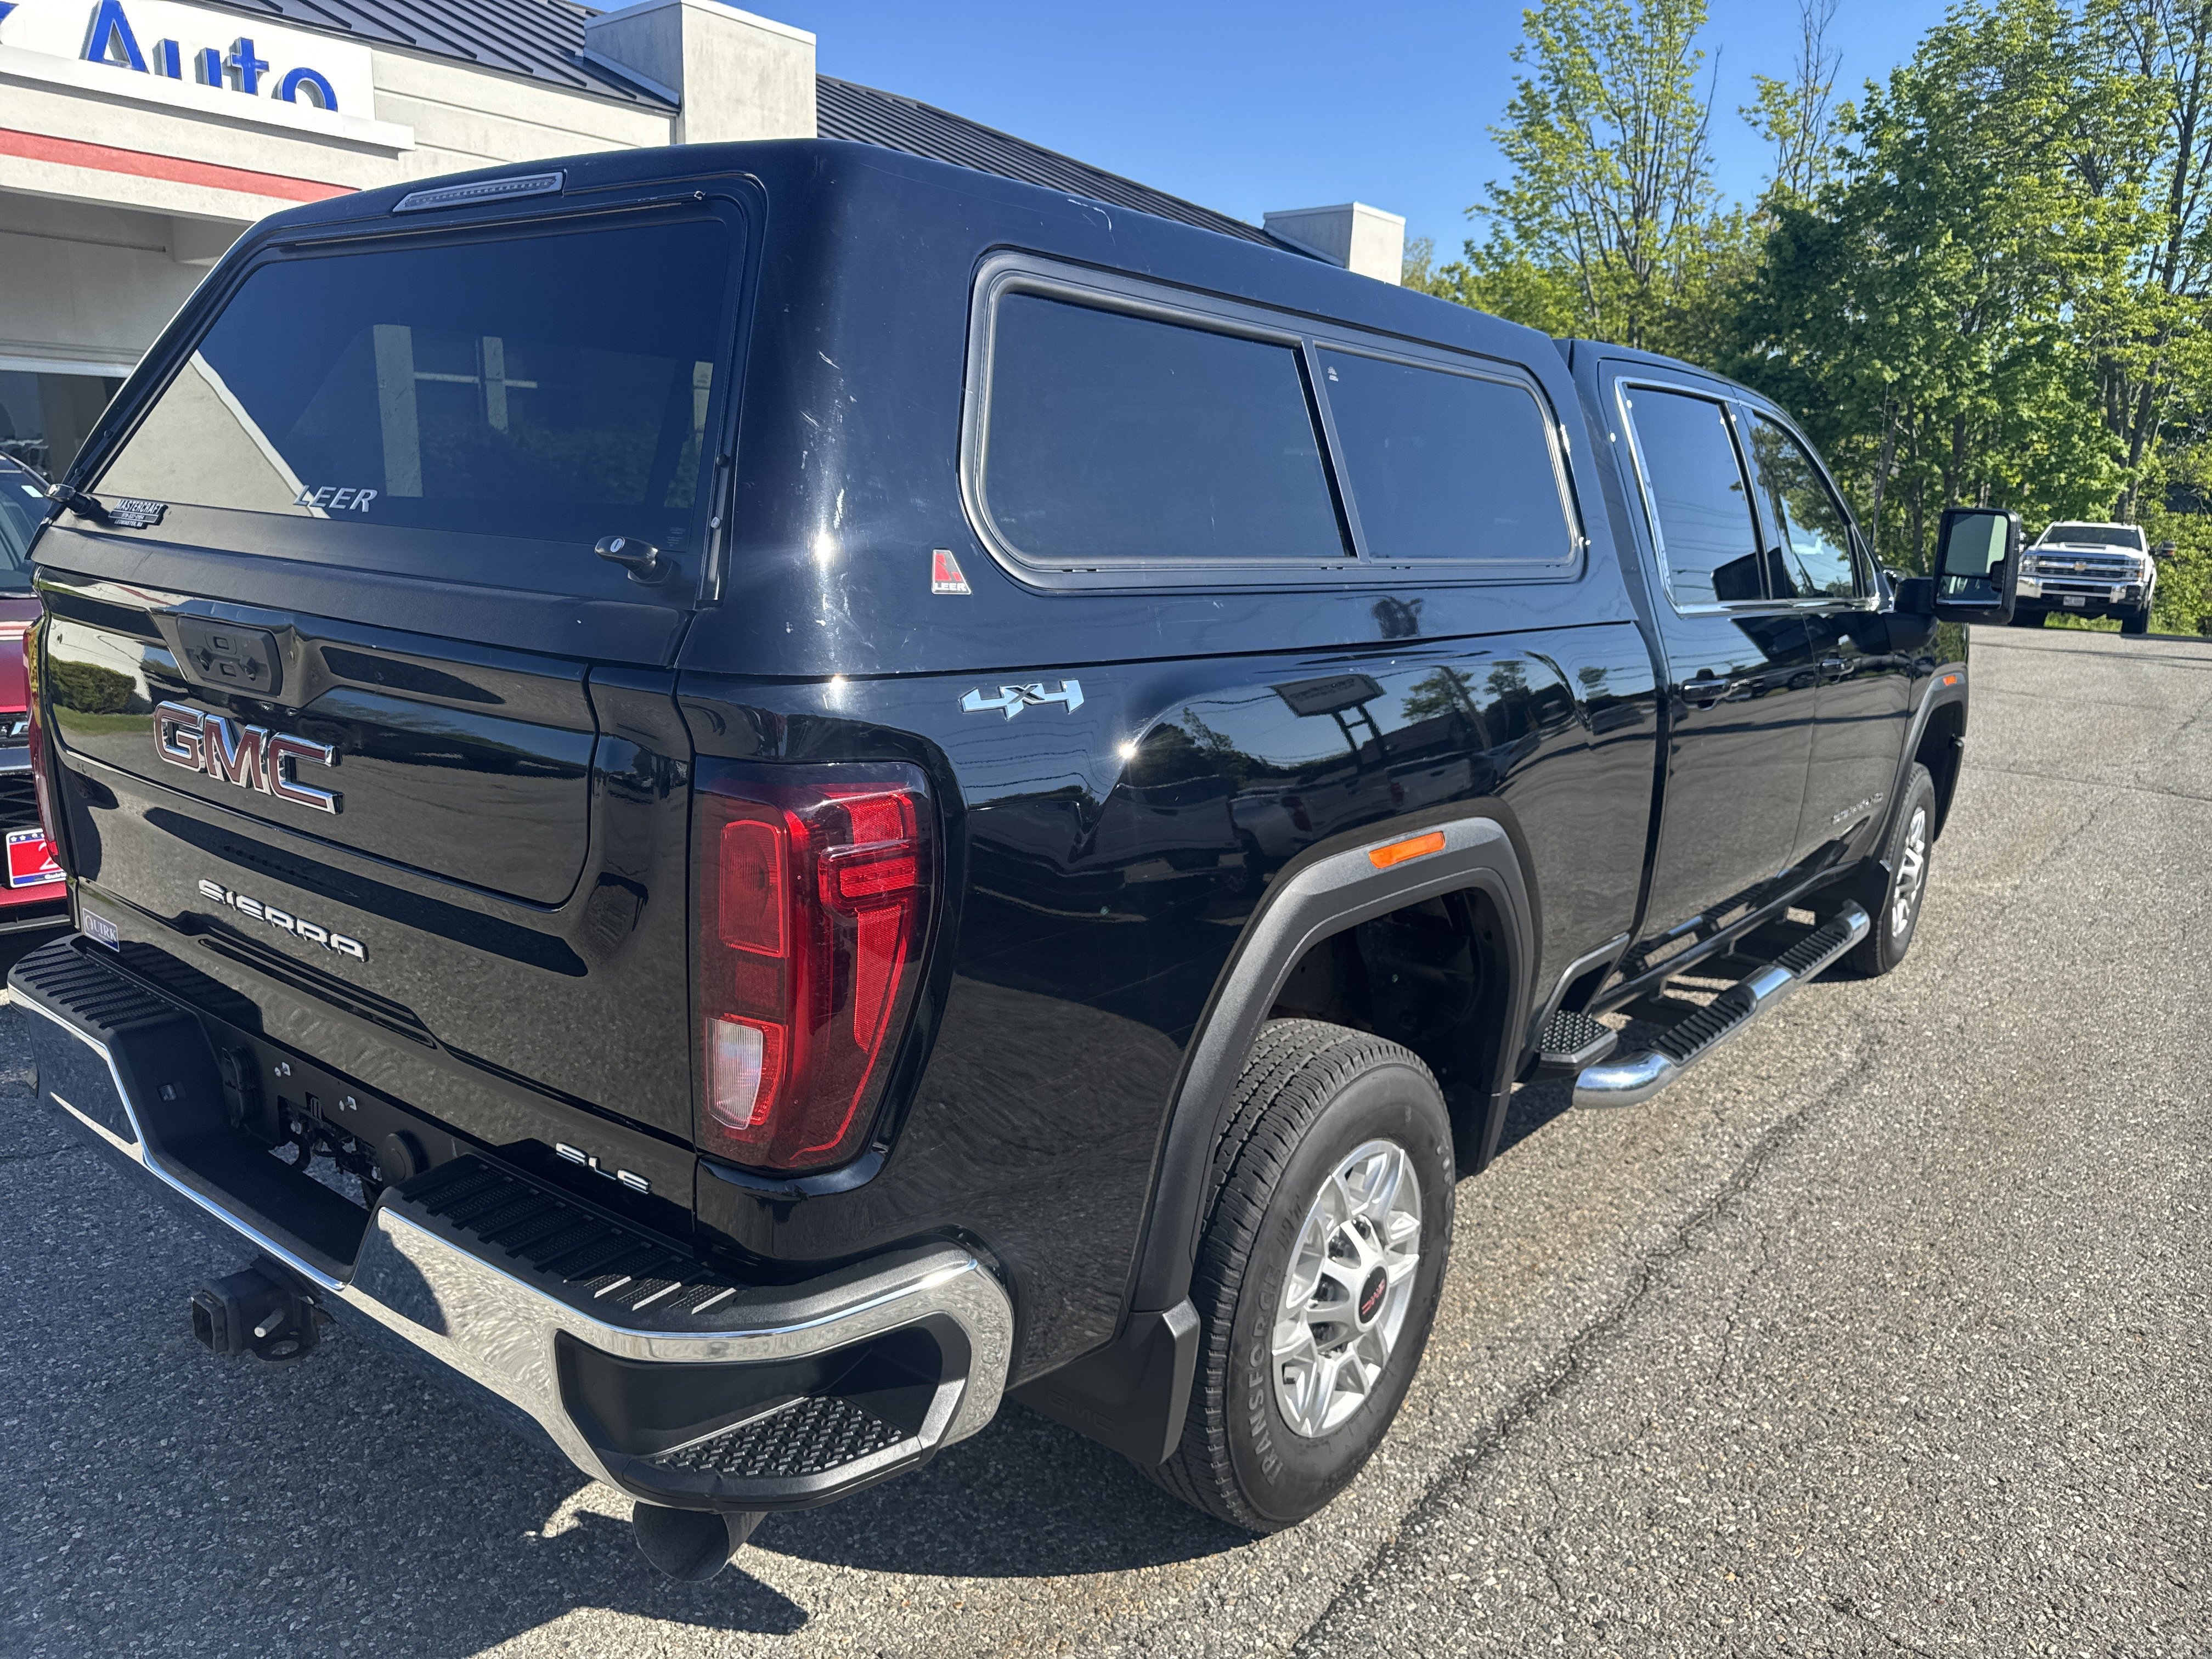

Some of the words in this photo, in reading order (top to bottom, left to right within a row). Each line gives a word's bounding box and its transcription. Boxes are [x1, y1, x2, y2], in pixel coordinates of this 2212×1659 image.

[80, 0, 338, 112] Auto
[114, 499, 165, 515] MASTERCRAFT
[293, 485, 378, 512] LEER
[934, 582, 967, 592] LEER
[154, 701, 343, 815] GMC
[84, 914, 117, 941] QUIRK
[198, 879, 369, 963] SIERRA
[555, 1142, 652, 1194] SLE
[1361, 1278, 1386, 1316] GMC
